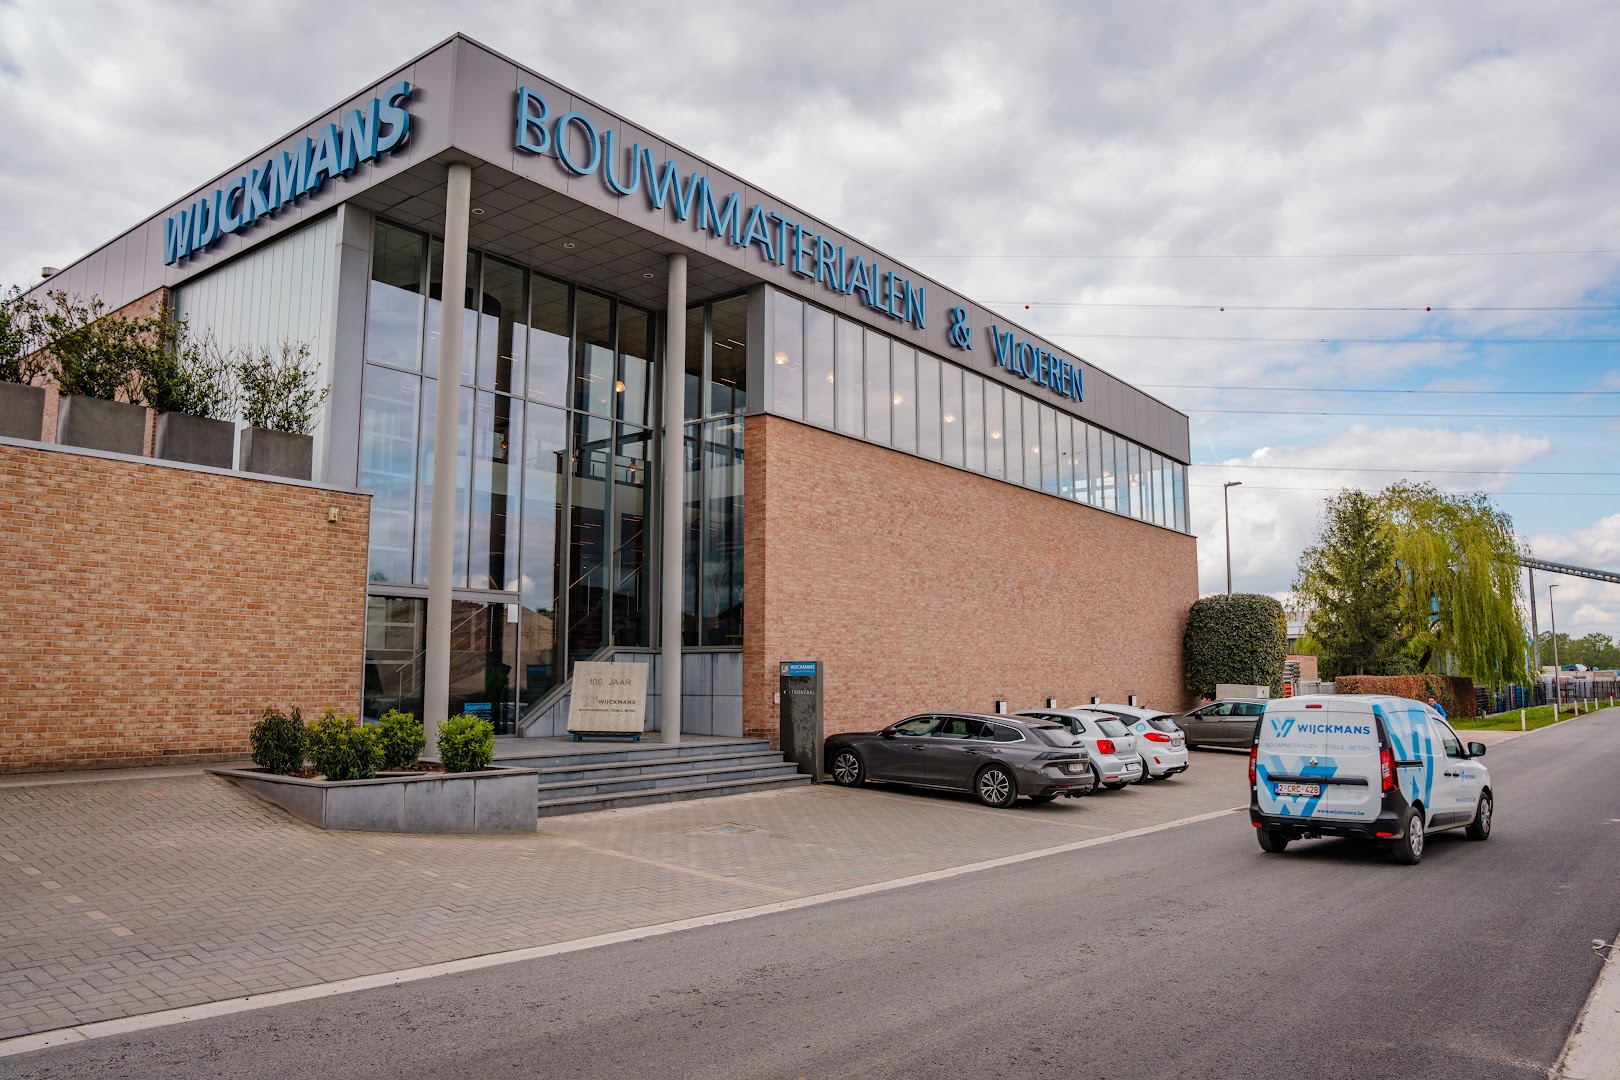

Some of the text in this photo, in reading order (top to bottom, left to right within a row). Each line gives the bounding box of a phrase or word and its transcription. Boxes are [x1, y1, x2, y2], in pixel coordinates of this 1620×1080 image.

[163, 80, 411, 266] WIJCKMANS
[516, 85, 1084, 402] BOUWMATERIALEN & VLOEREN
[589, 678, 632, 686] 100 JAAR
[1297, 724, 1371, 735] WIJCKMANS
[1317, 808, 1365, 816] www.wijckmans.be
